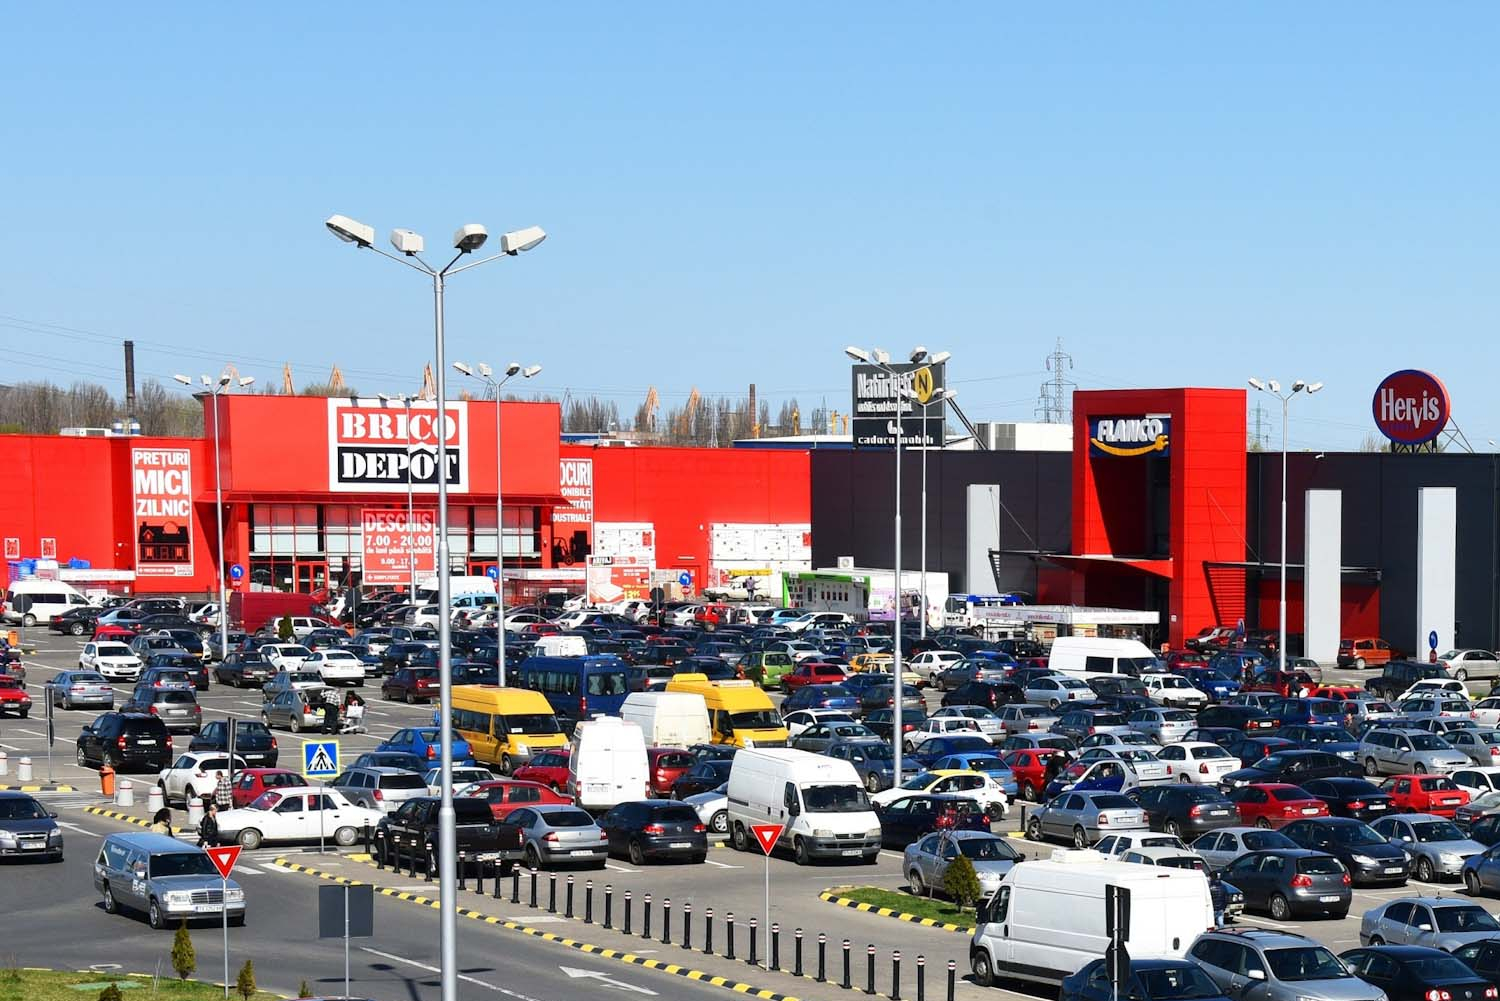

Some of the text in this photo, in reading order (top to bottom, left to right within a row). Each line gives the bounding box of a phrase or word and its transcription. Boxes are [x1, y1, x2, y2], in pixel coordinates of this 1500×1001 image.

[1381, 388, 1440, 429] Hervis
[341, 413, 456, 440] BRICO
[1097, 419, 1163, 442] FLANCO
[858, 435, 934, 444] cadoro mobli
[134, 452, 188, 468] PREȚURI
[135, 469, 189, 495] MICI
[136, 499, 190, 517] ZILNIC
[365, 513, 432, 532] DESCHIS
[366, 535, 390, 546] 7.00
